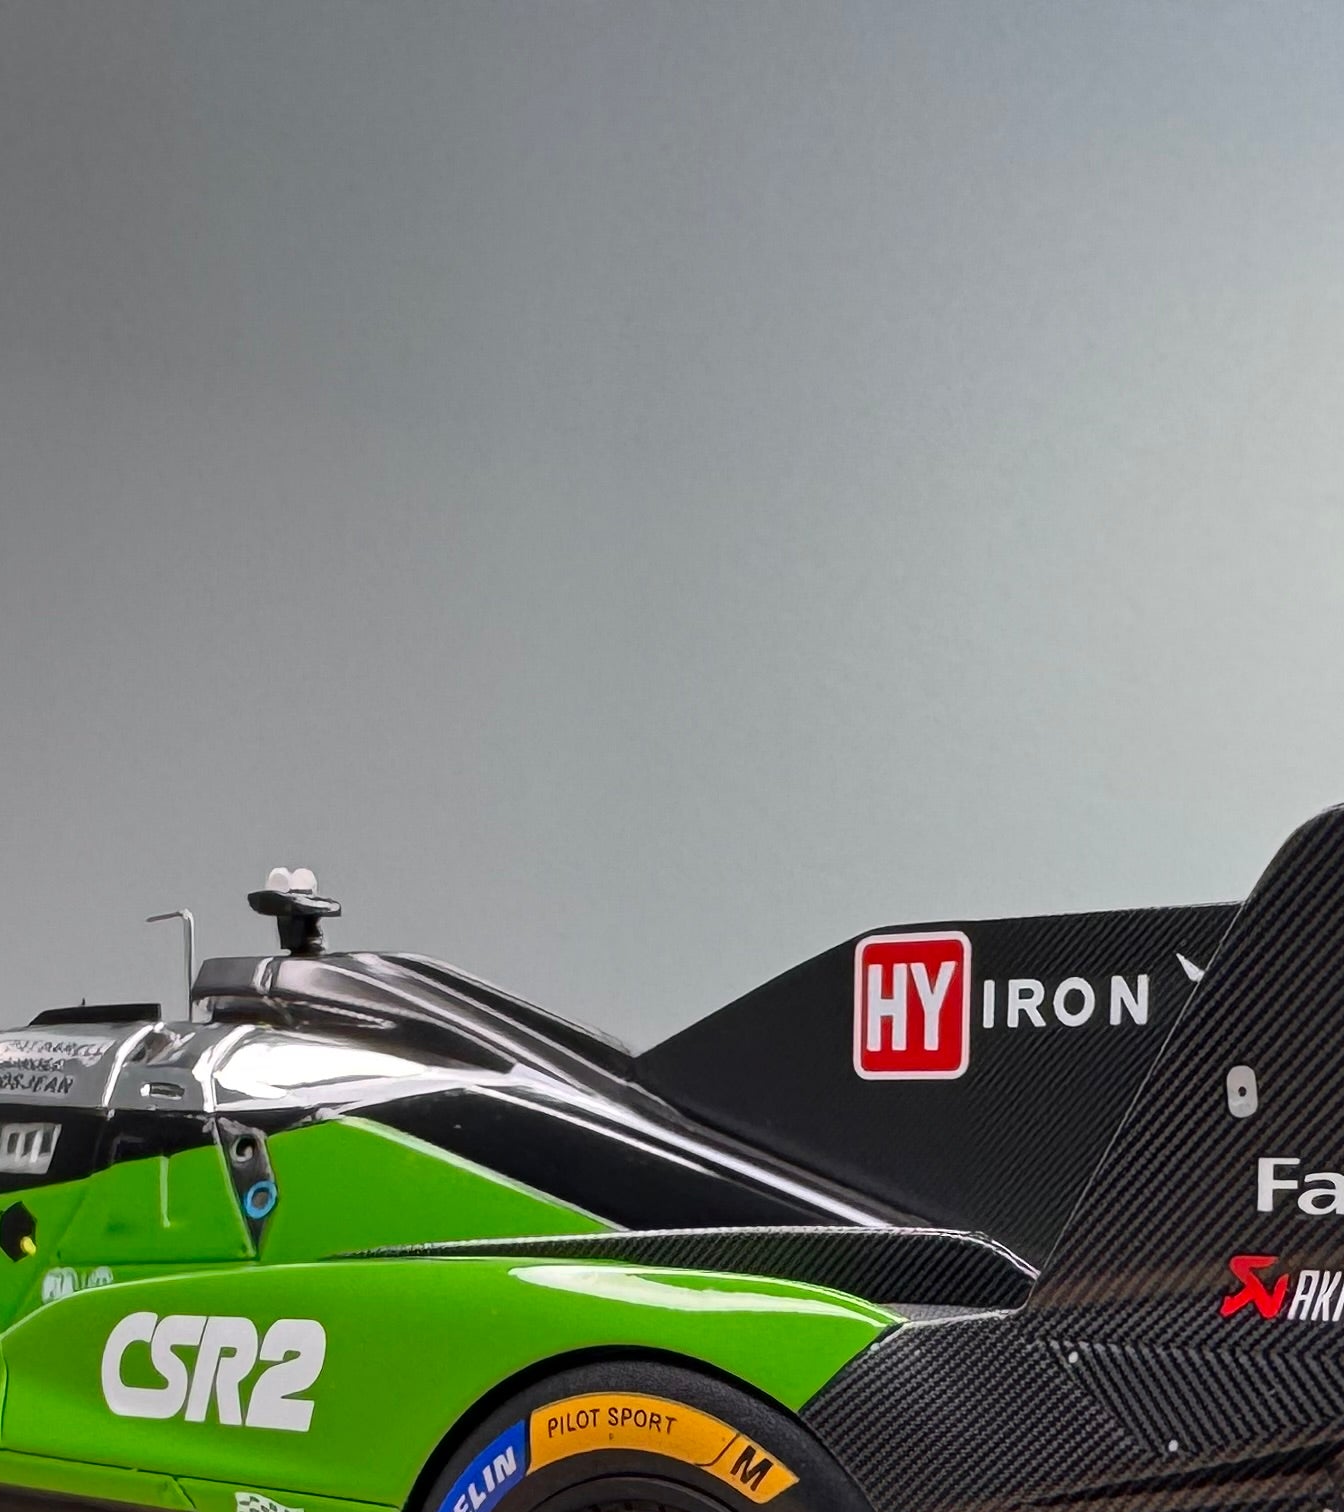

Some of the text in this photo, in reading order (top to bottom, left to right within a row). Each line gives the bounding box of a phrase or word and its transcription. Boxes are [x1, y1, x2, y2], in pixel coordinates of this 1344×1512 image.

[865, 960, 1149, 1053] HY IRON
[101, 1311, 327, 1432] CSR2
[547, 1407, 677, 1438] PILOT SPORT
[729, 1445, 774, 1492] M
